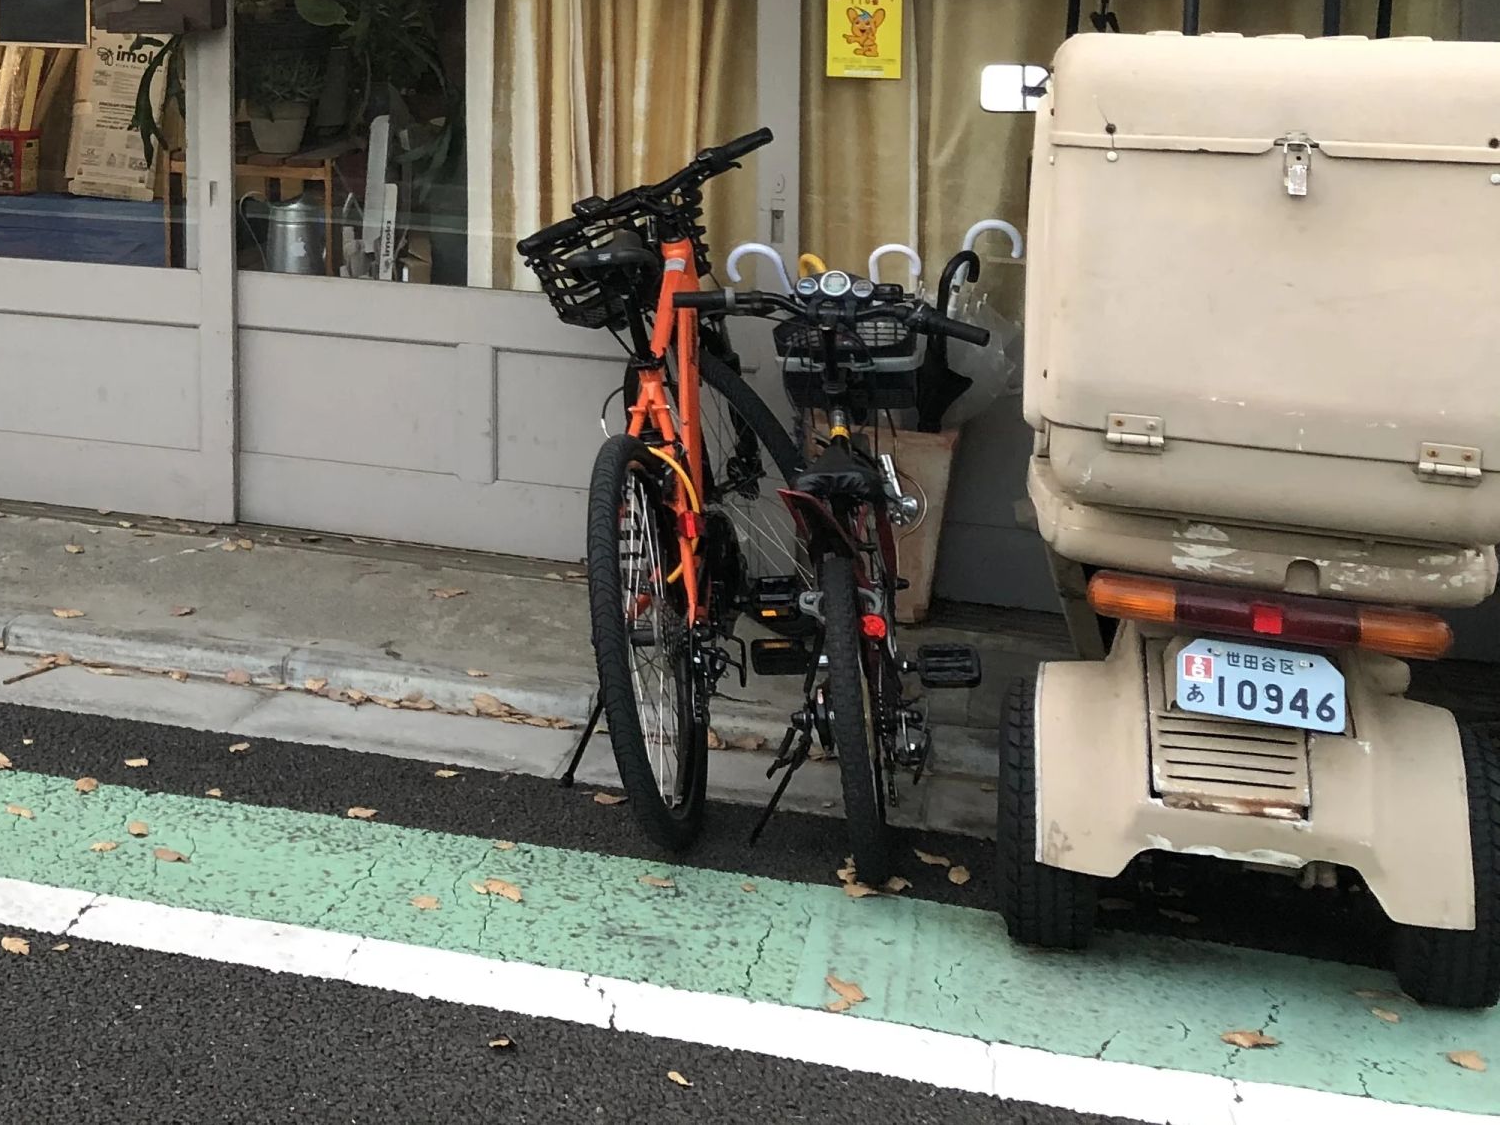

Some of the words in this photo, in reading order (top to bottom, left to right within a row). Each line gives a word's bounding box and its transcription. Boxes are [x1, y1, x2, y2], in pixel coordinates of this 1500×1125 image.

[115, 44, 164, 67] imol
[1226, 650, 1295, 676] 世田谷区
[1186, 683, 1205, 704] あ
[1217, 675, 1337, 723] 10946
